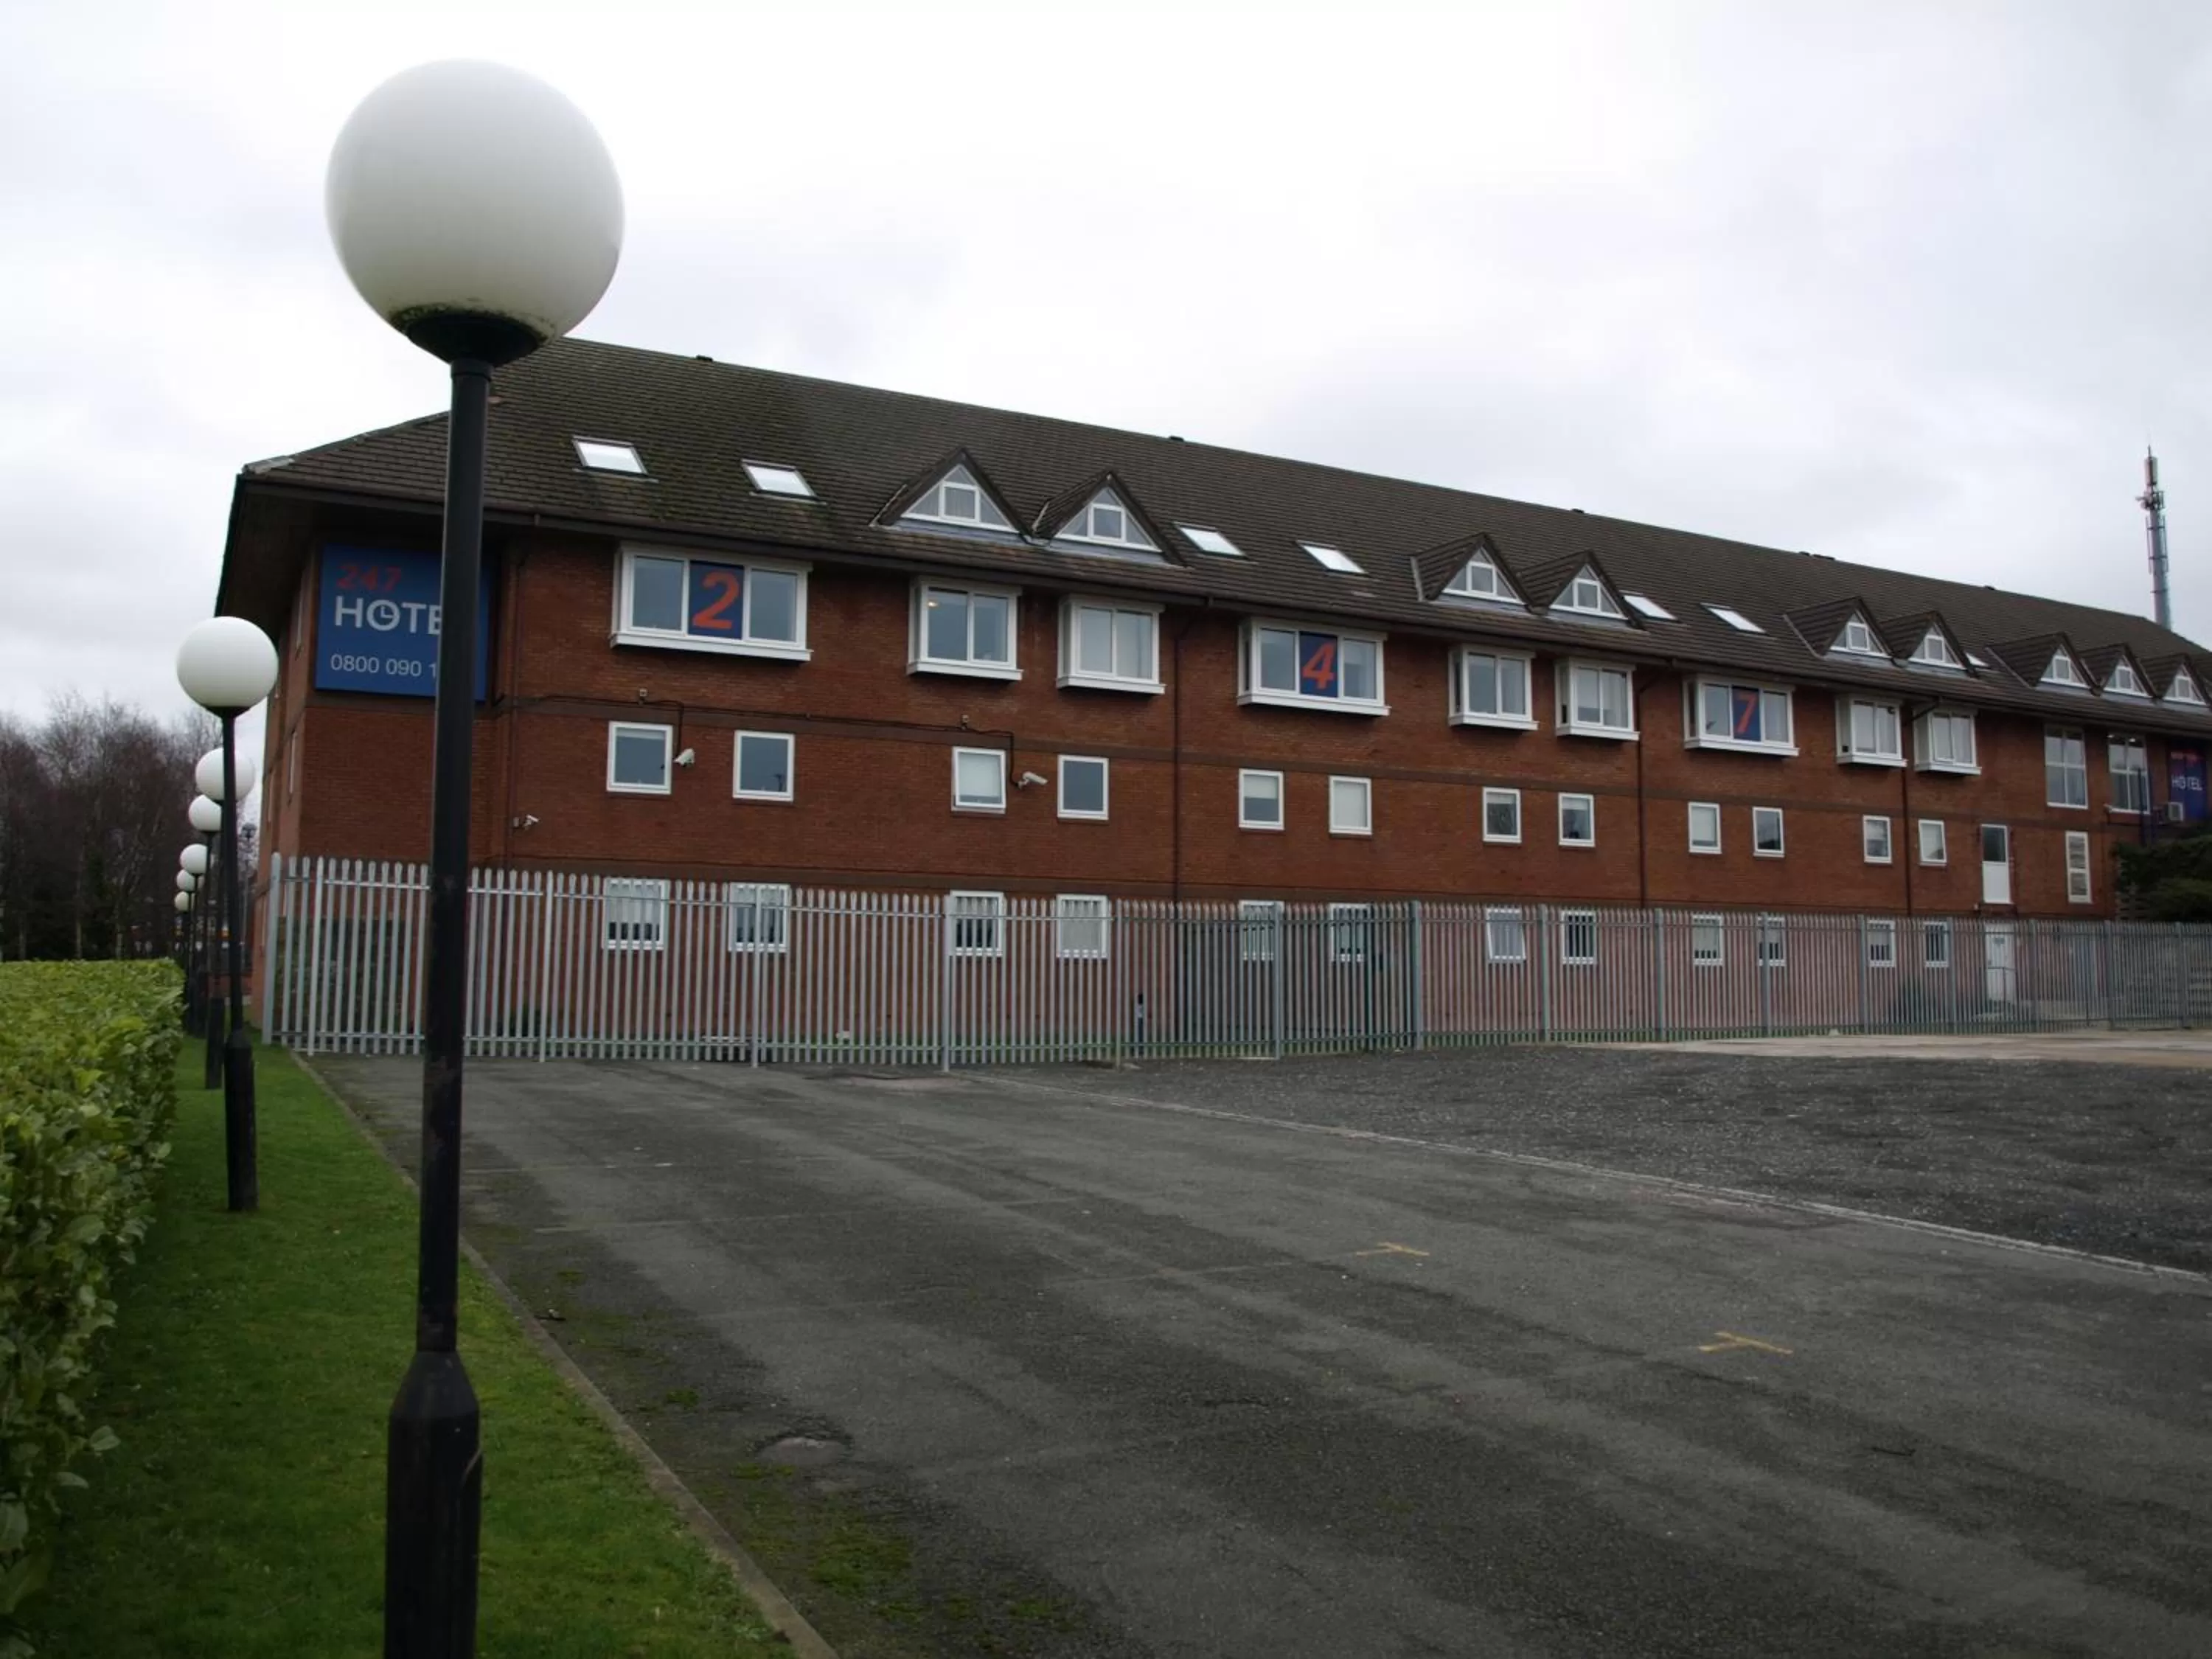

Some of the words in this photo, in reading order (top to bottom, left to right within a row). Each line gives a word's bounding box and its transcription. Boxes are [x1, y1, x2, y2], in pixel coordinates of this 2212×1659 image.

[335, 563, 403, 593] 247
[334, 595, 443, 636] HOTE
[692, 571, 740, 630] 2
[330, 653, 380, 674] 0800
[386, 658, 422, 677] 090
[1302, 642, 1336, 689] 4
[1736, 690, 1757, 734] 7
[2171, 774, 2203, 791] HOTEL
